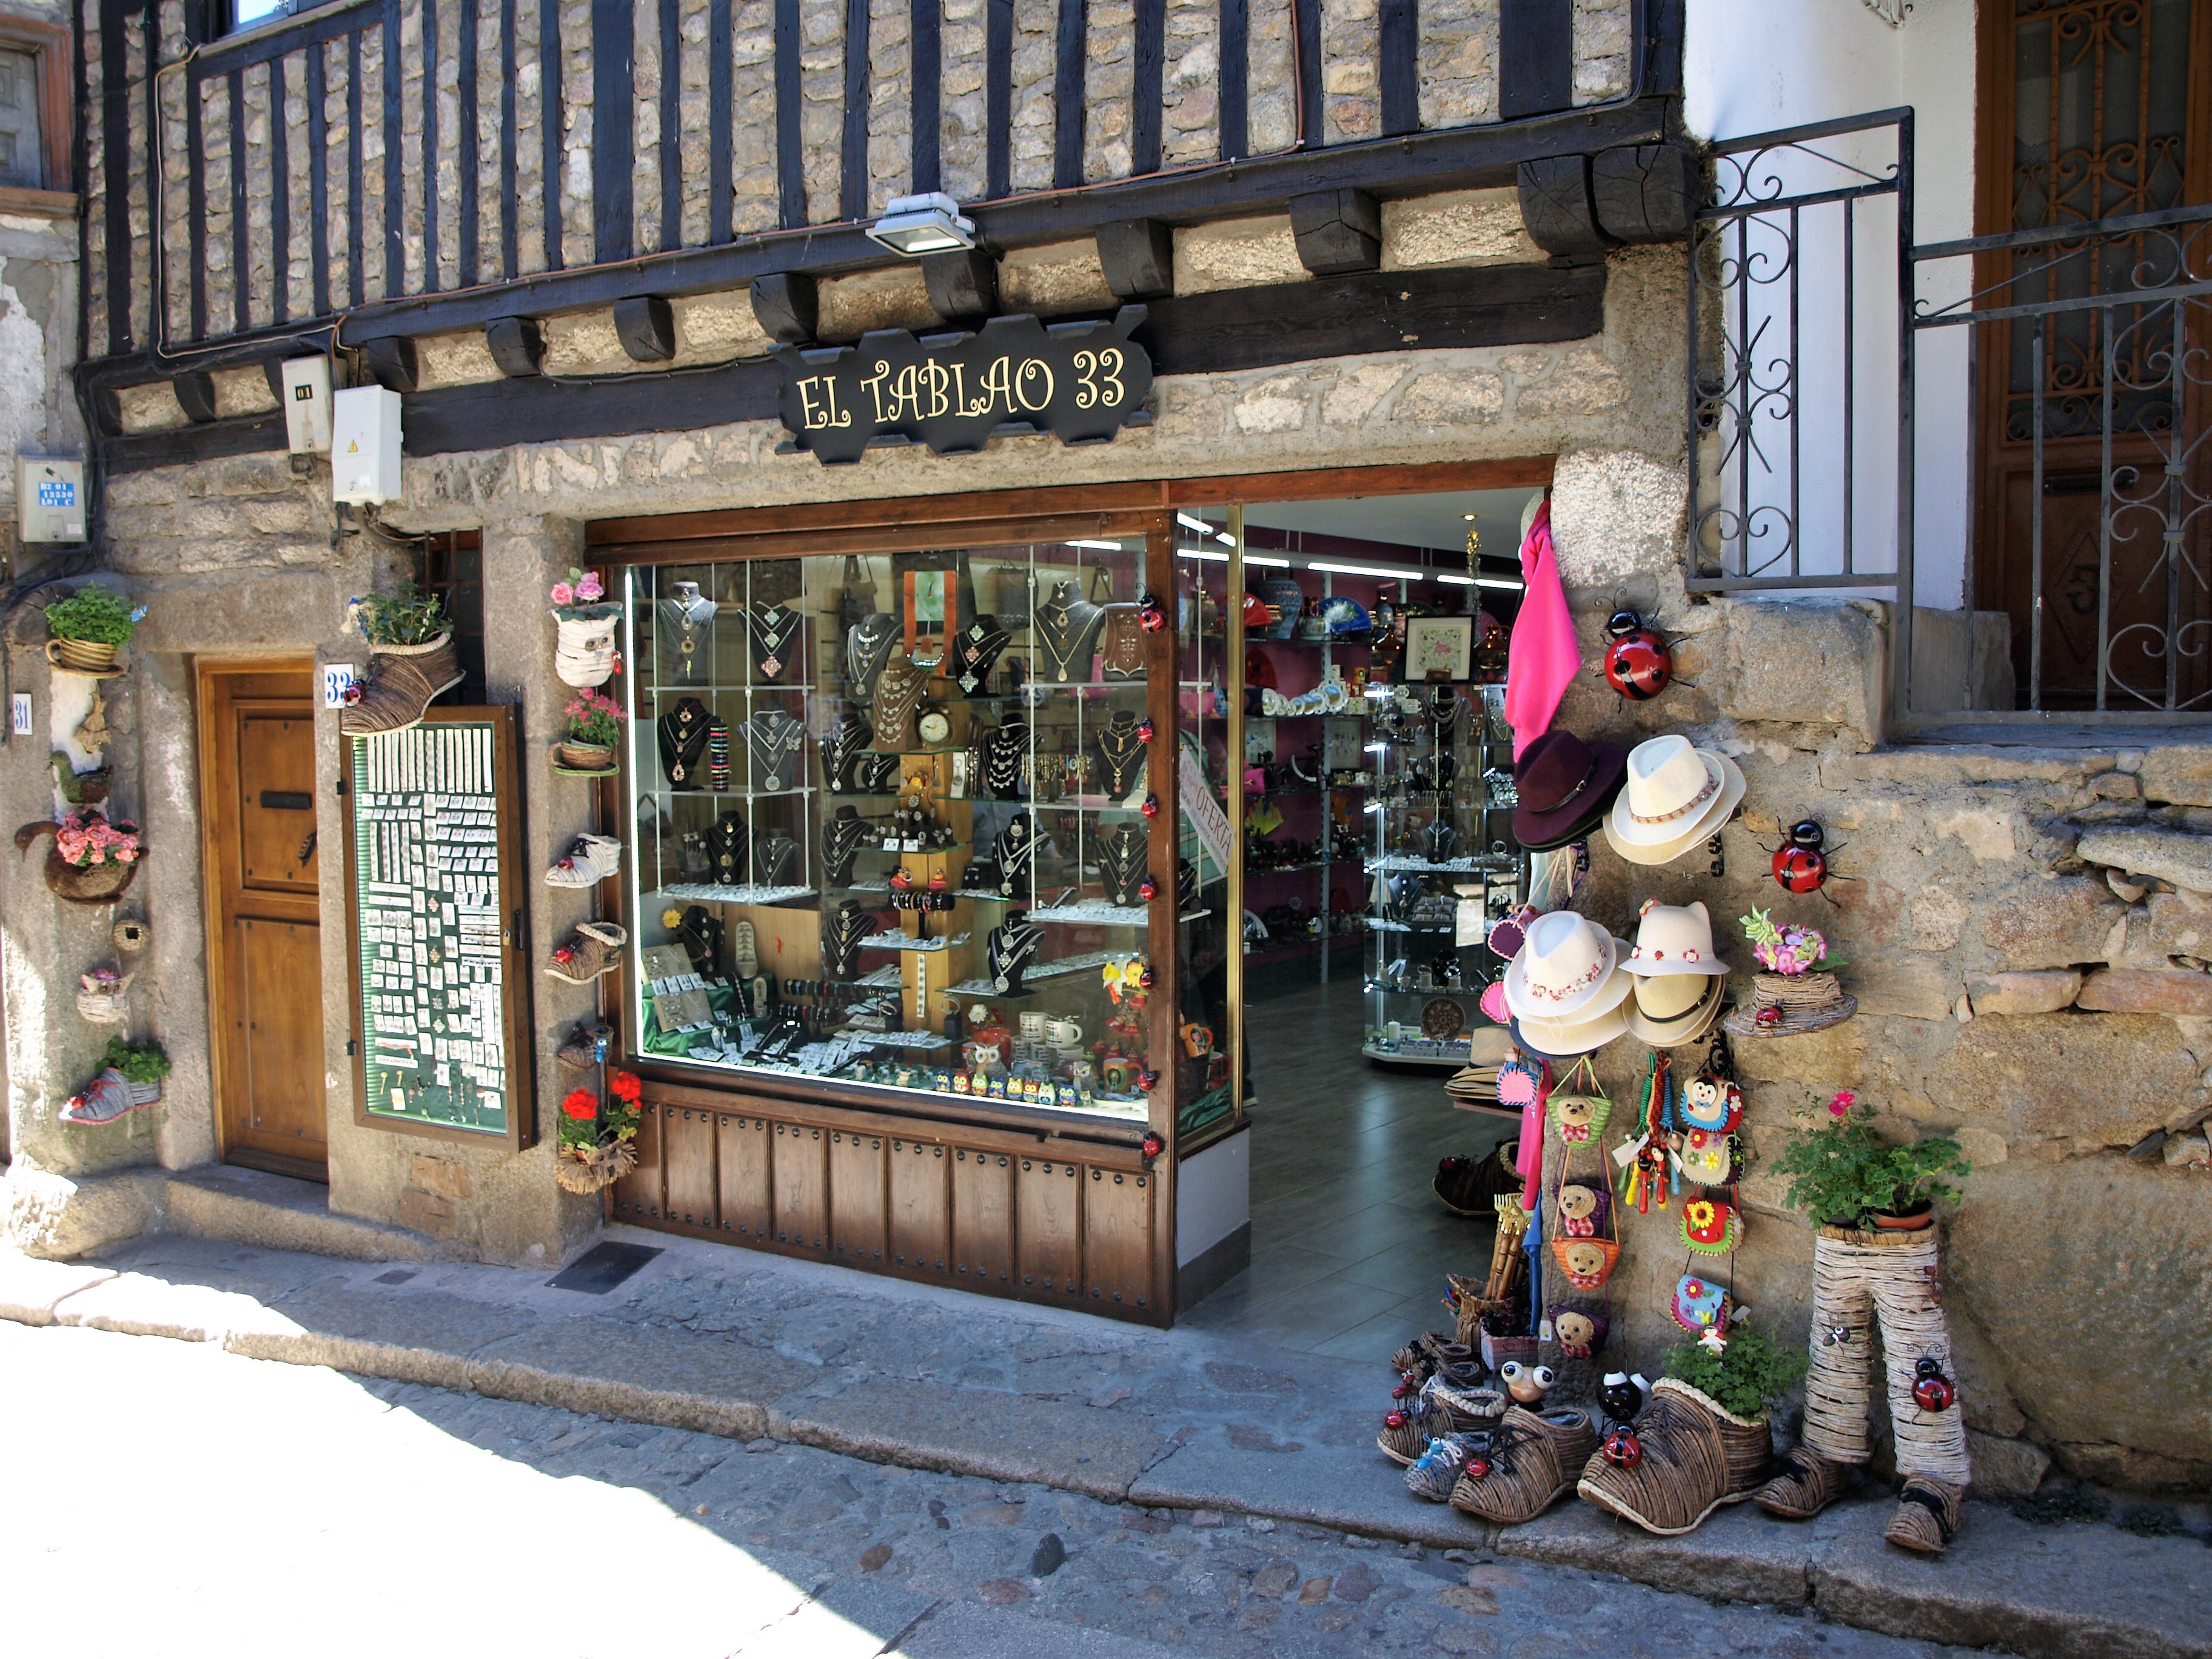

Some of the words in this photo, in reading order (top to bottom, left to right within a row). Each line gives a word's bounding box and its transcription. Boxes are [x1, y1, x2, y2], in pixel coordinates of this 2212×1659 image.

[796, 375, 852, 429] EL
[860, 356, 1055, 424] TABLAO
[1073, 347, 1125, 409] 33
[15, 700, 28, 729] 31
[1196, 786, 1232, 857] OFERTA
